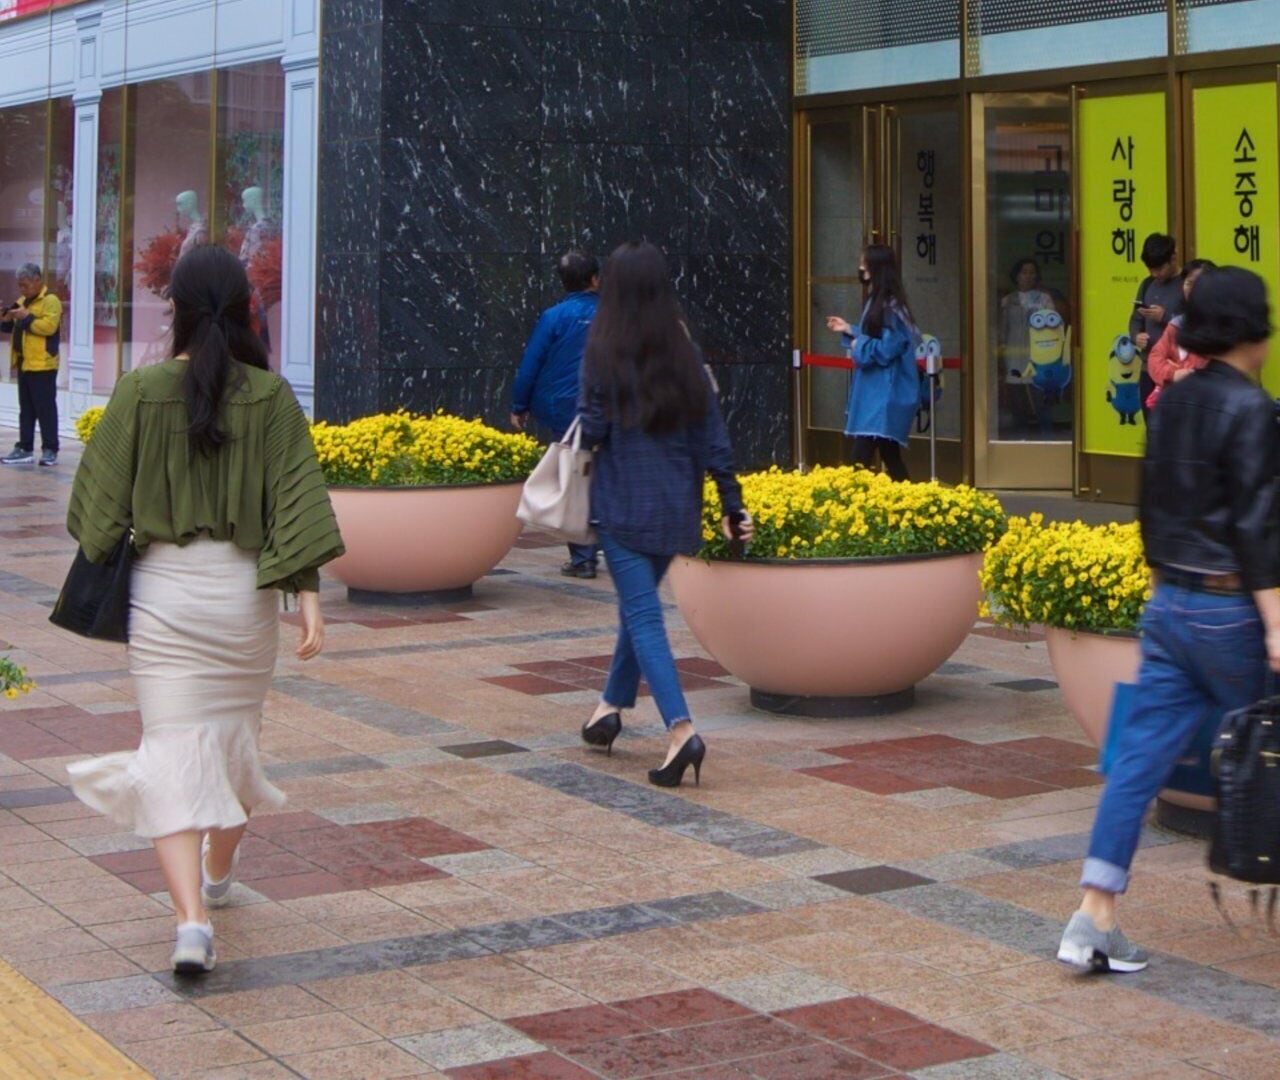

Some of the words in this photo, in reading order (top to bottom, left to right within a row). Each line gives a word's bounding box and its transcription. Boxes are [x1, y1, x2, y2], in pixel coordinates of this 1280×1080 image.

[916, 149, 937, 265] 행복해
[1034, 145, 1066, 264] 고마워
[1110, 135, 1137, 264] 사랑해
[1232, 127, 1261, 263] 소중해
